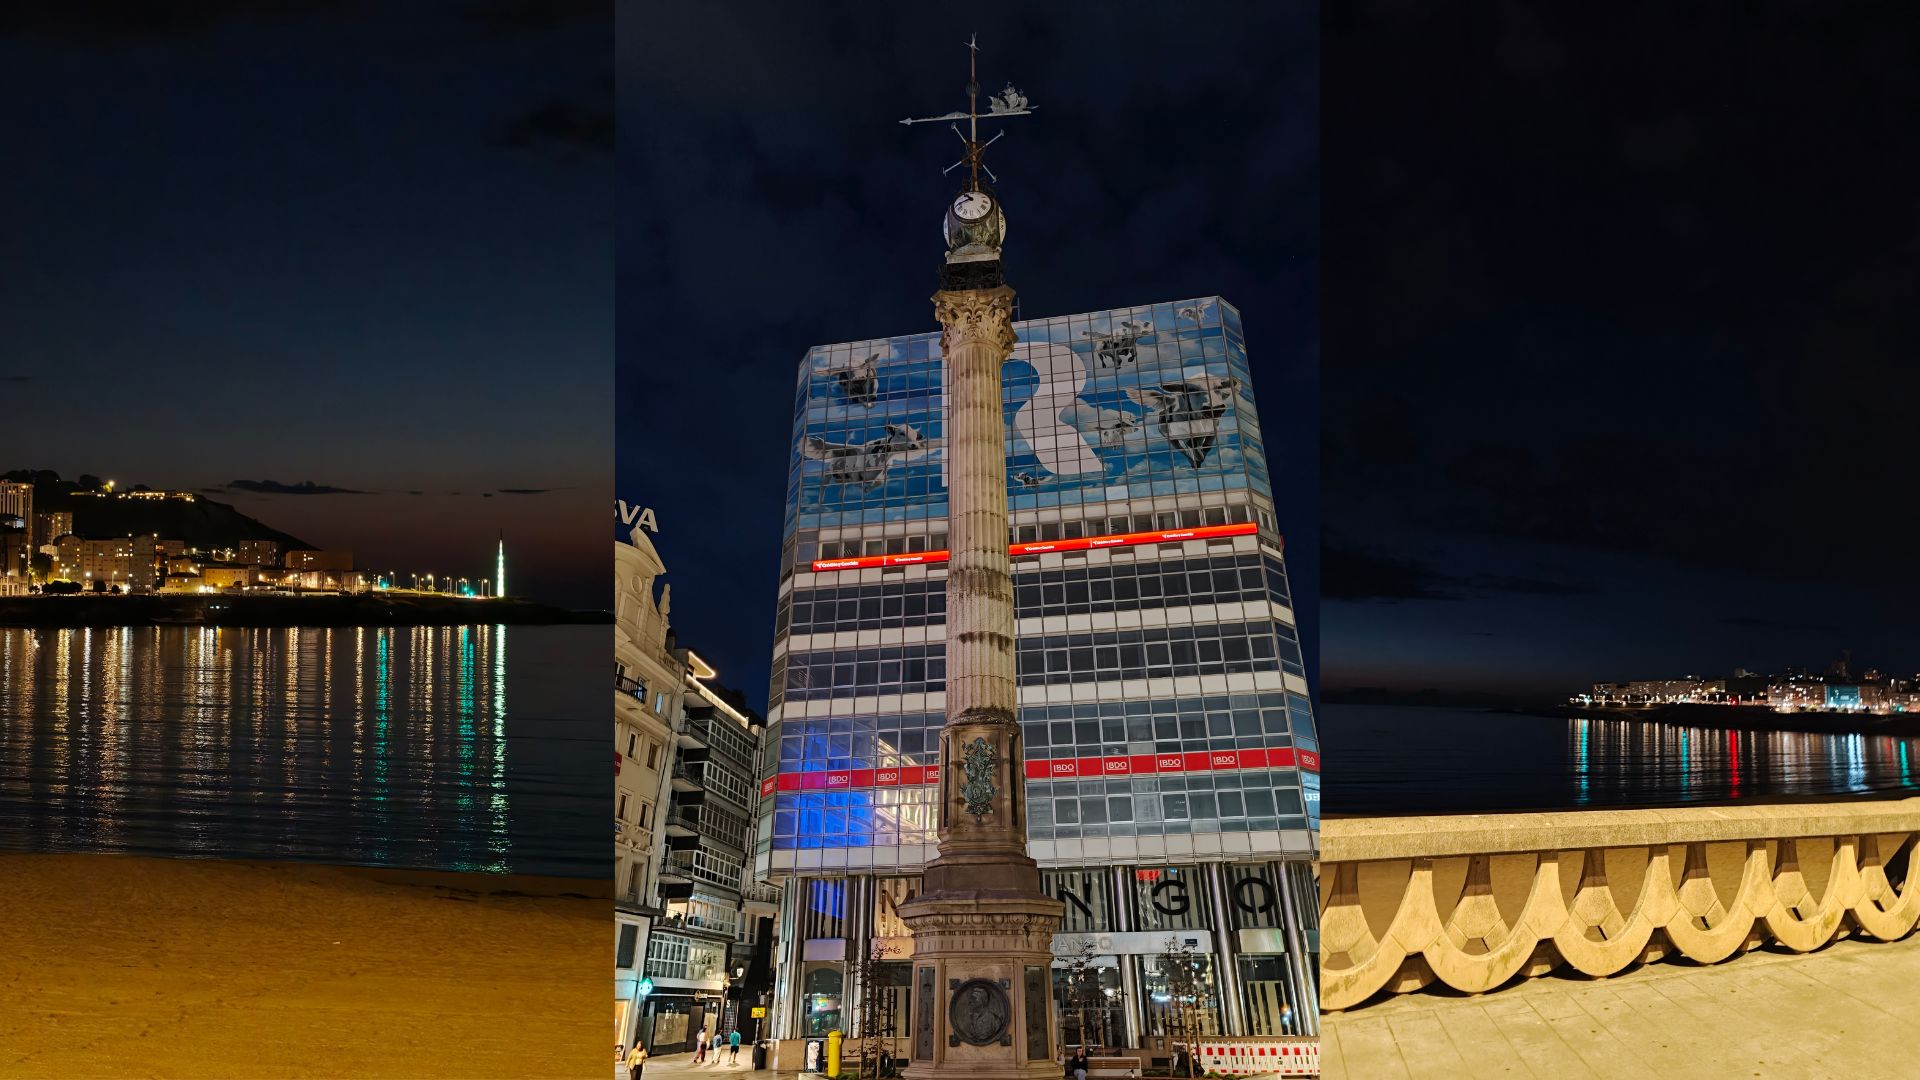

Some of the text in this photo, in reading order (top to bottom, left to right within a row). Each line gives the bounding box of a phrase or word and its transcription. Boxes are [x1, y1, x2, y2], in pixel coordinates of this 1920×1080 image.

[615, 499, 659, 533] VA
[1160, 759, 1181, 768] BDO
[1213, 755, 1236, 765] BDO
[1053, 764, 1075, 773] BDO
[1106, 761, 1127, 771] BDO
[828, 775, 849, 785] BDO
[877, 772, 897, 782] BDO
[927, 770, 940, 780] BD
